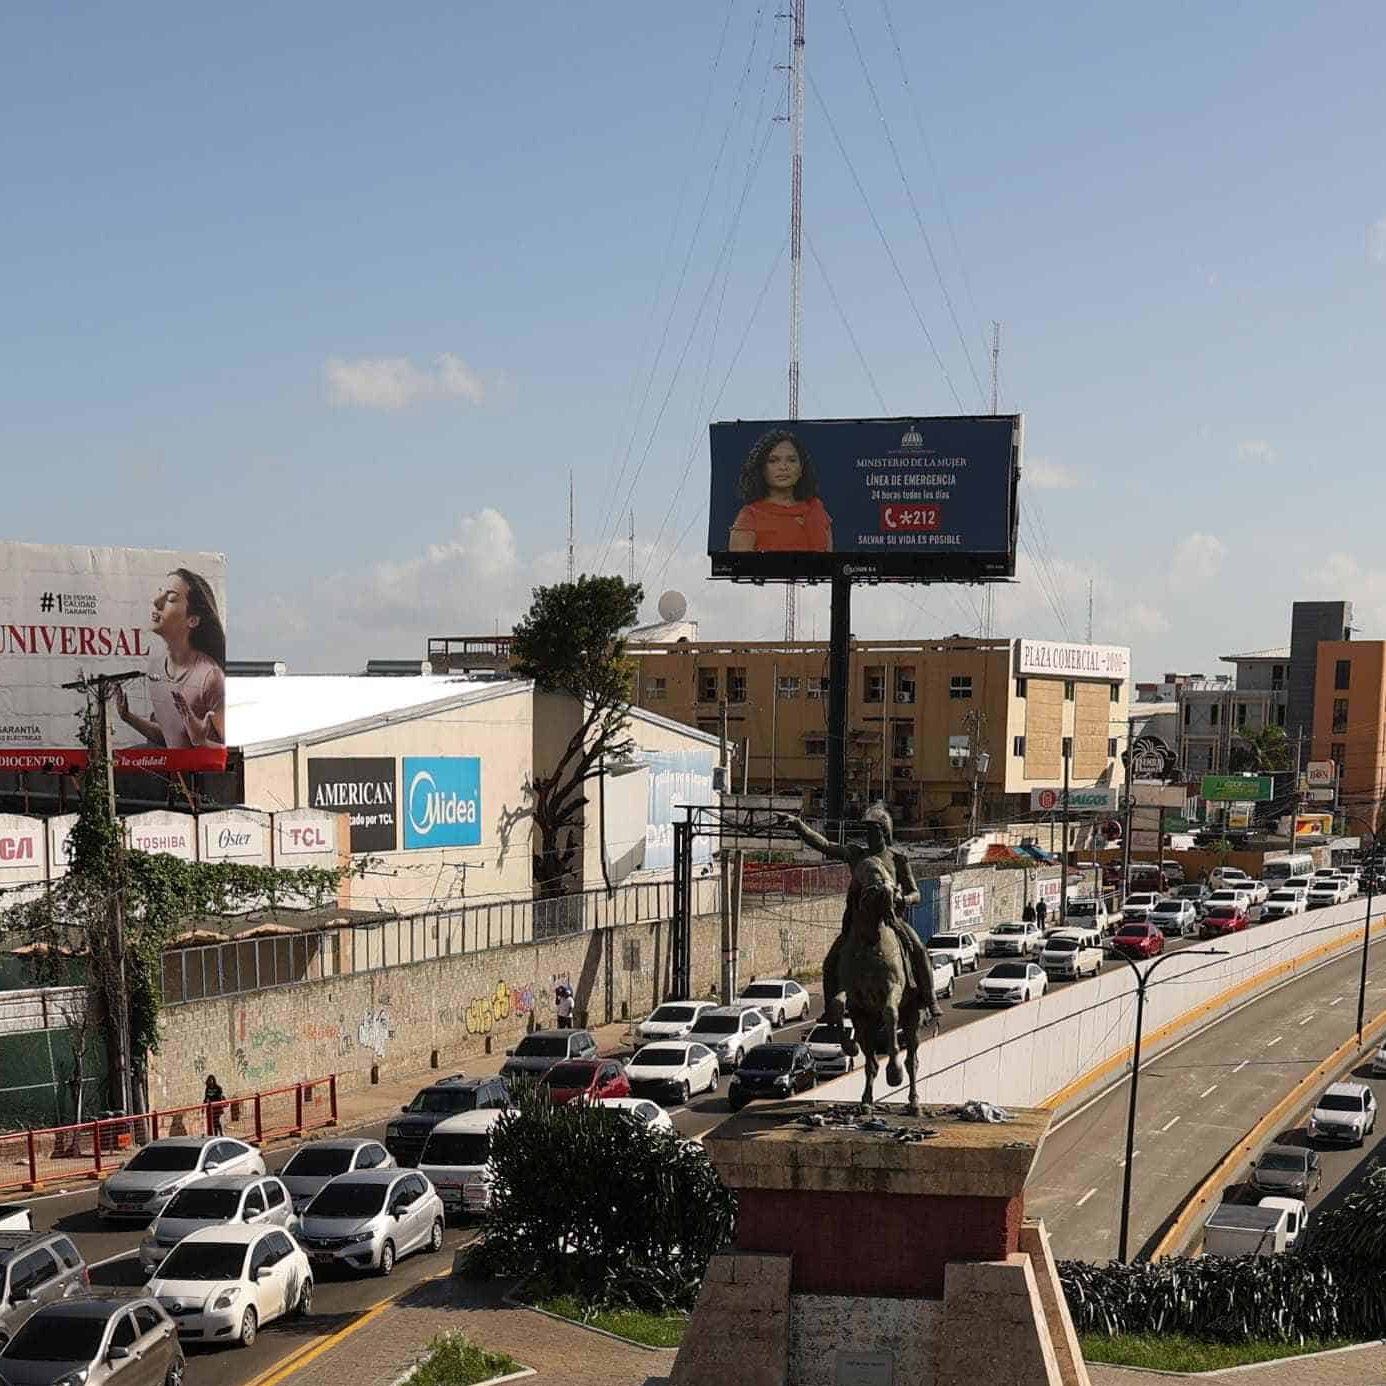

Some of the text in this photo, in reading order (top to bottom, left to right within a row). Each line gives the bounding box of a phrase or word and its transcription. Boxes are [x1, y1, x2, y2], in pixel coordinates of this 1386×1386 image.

[911, 457, 923, 467] DE
[925, 457, 936, 467] LA
[891, 474, 902, 485] DE
[904, 474, 956, 486] EMERGENCIA
[858, 534, 962, 545] SALVAR SU VIDA ES POSIBLE
[40, 592, 63, 613] #1
[63, 600, 97, 608] CALIDAD
[1023, 645, 1051, 668] PLAZA
[1053, 647, 1100, 672] COMERCIAL
[121, 756, 131, 767] la
[131, 755, 167, 769] calidad!
[314, 781, 394, 808] AMERICAN
[419, 790, 477, 826] Midea
[365, 814, 377, 828] por
[379, 813, 394, 825] TCL
[135, 835, 186, 850] TOSHIBA
[218, 827, 252, 850] Oster
[289, 827, 326, 848] TCL
